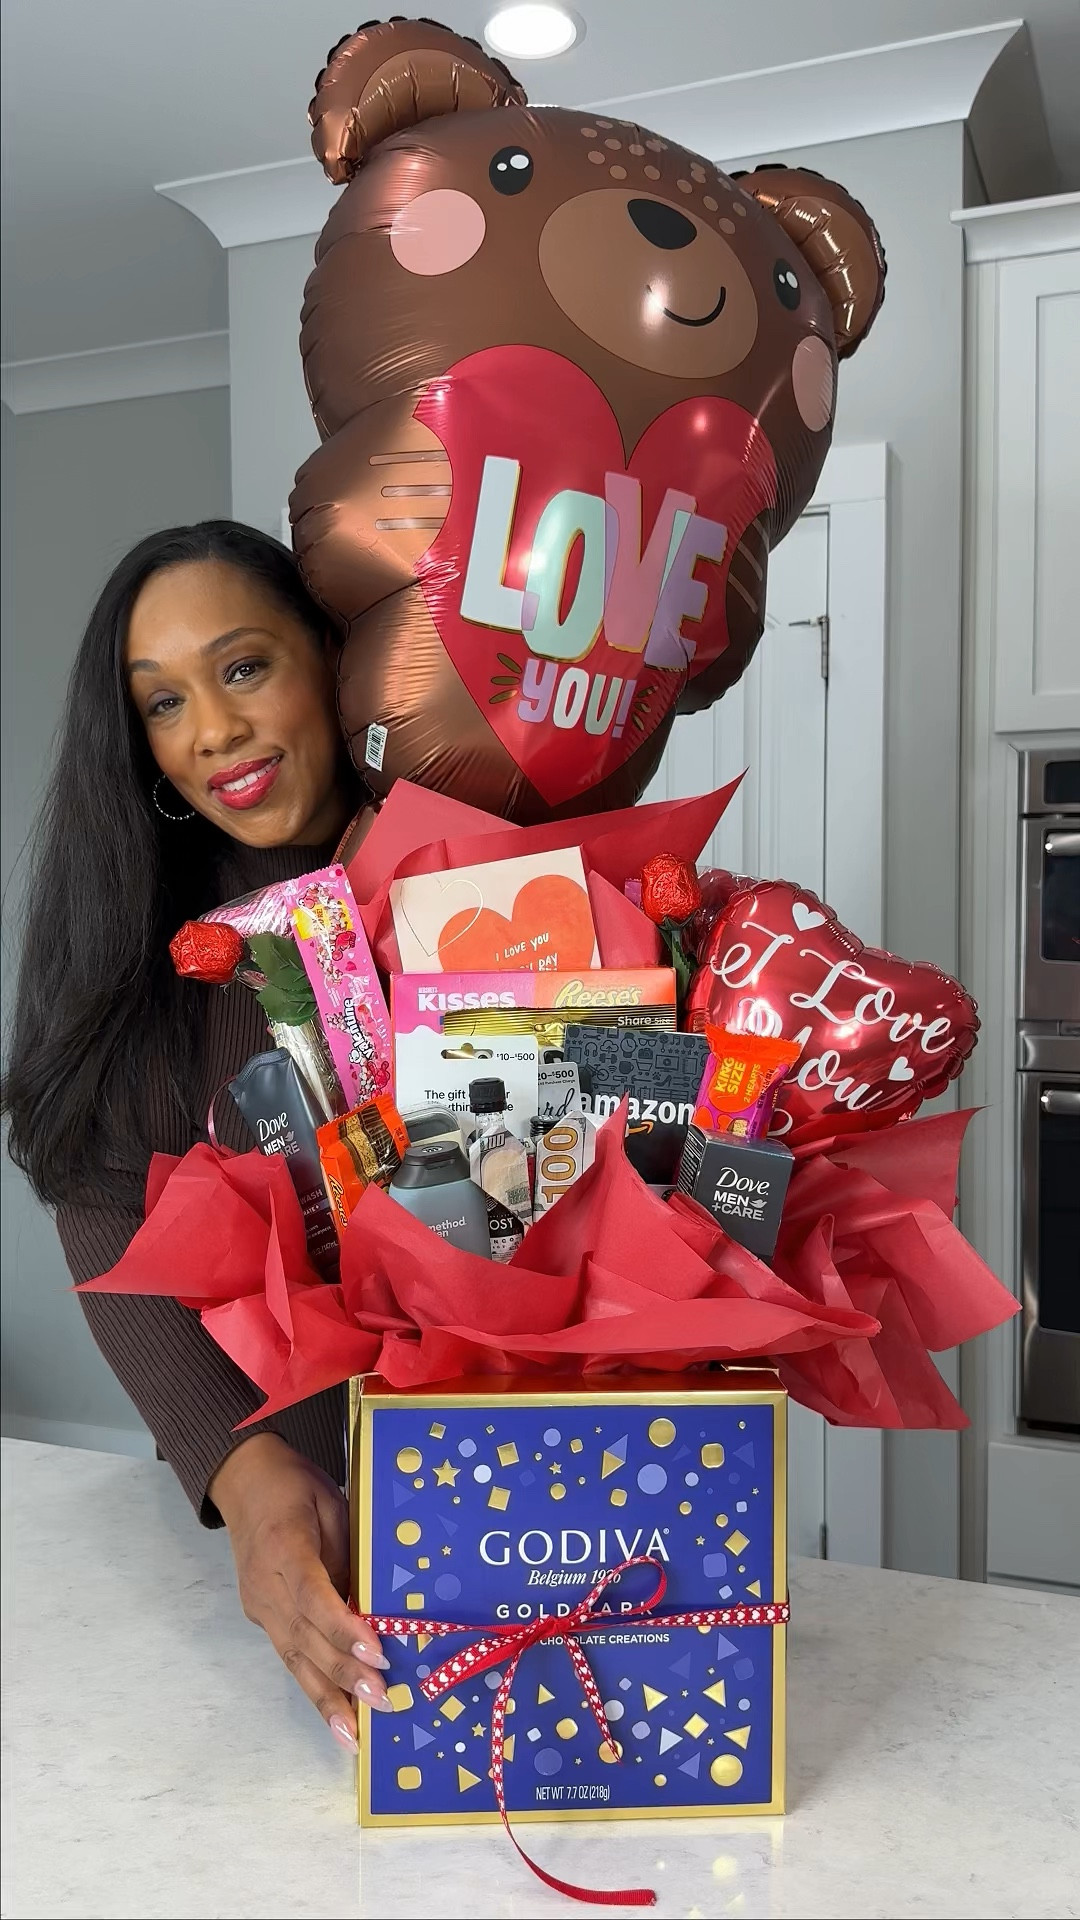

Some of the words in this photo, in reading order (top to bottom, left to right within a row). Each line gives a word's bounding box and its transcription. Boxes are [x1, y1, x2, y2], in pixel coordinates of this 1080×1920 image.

[460, 455, 728, 672] LOVE
[517, 658, 638, 738] YOU!
[495, 953, 500, 962] I
[504, 942, 527, 959] LOVE
[530, 933, 550, 952] YOU
[555, 979, 644, 1008] Reese's
[710, 921, 795, 989] I
[790, 948, 956, 1054] Love
[617, 1016, 652, 1026] Share
[714, 1057, 735, 1093] KING
[727, 1061, 747, 1095] SIZE
[747, 1064, 761, 1097] HEARTS
[425, 1090, 445, 1099] The
[448, 1090, 466, 1101] gift
[580, 1092, 696, 1125] amazon
[256, 1112, 289, 1142] Dove
[263, 1135, 286, 1157] MEN
[272, 1141, 300, 1158] ARE
[541, 1126, 579, 1203] 100
[716, 1167, 770, 1195] Dove
[712, 1202, 765, 1221] +CARE
[714, 1190, 750, 1207] MEN
[437, 1229, 449, 1238] en
[489, 1217, 514, 1231] OST
[479, 1528, 670, 1566] GODIVA
[528, 1569, 587, 1587] Belgium
[496, 1601, 652, 1619] GOLDARK
[540, 1635, 606, 1646] CHOOLATE
[608, 1633, 670, 1645] CREATIONS
[536, 1786, 550, 1800] NET
[551, 1786, 564, 1800] WT
[567, 1786, 578, 1800] 7.7
[579, 1785, 588, 1799] OZ
[589, 1785, 610, 1801] (218g)
